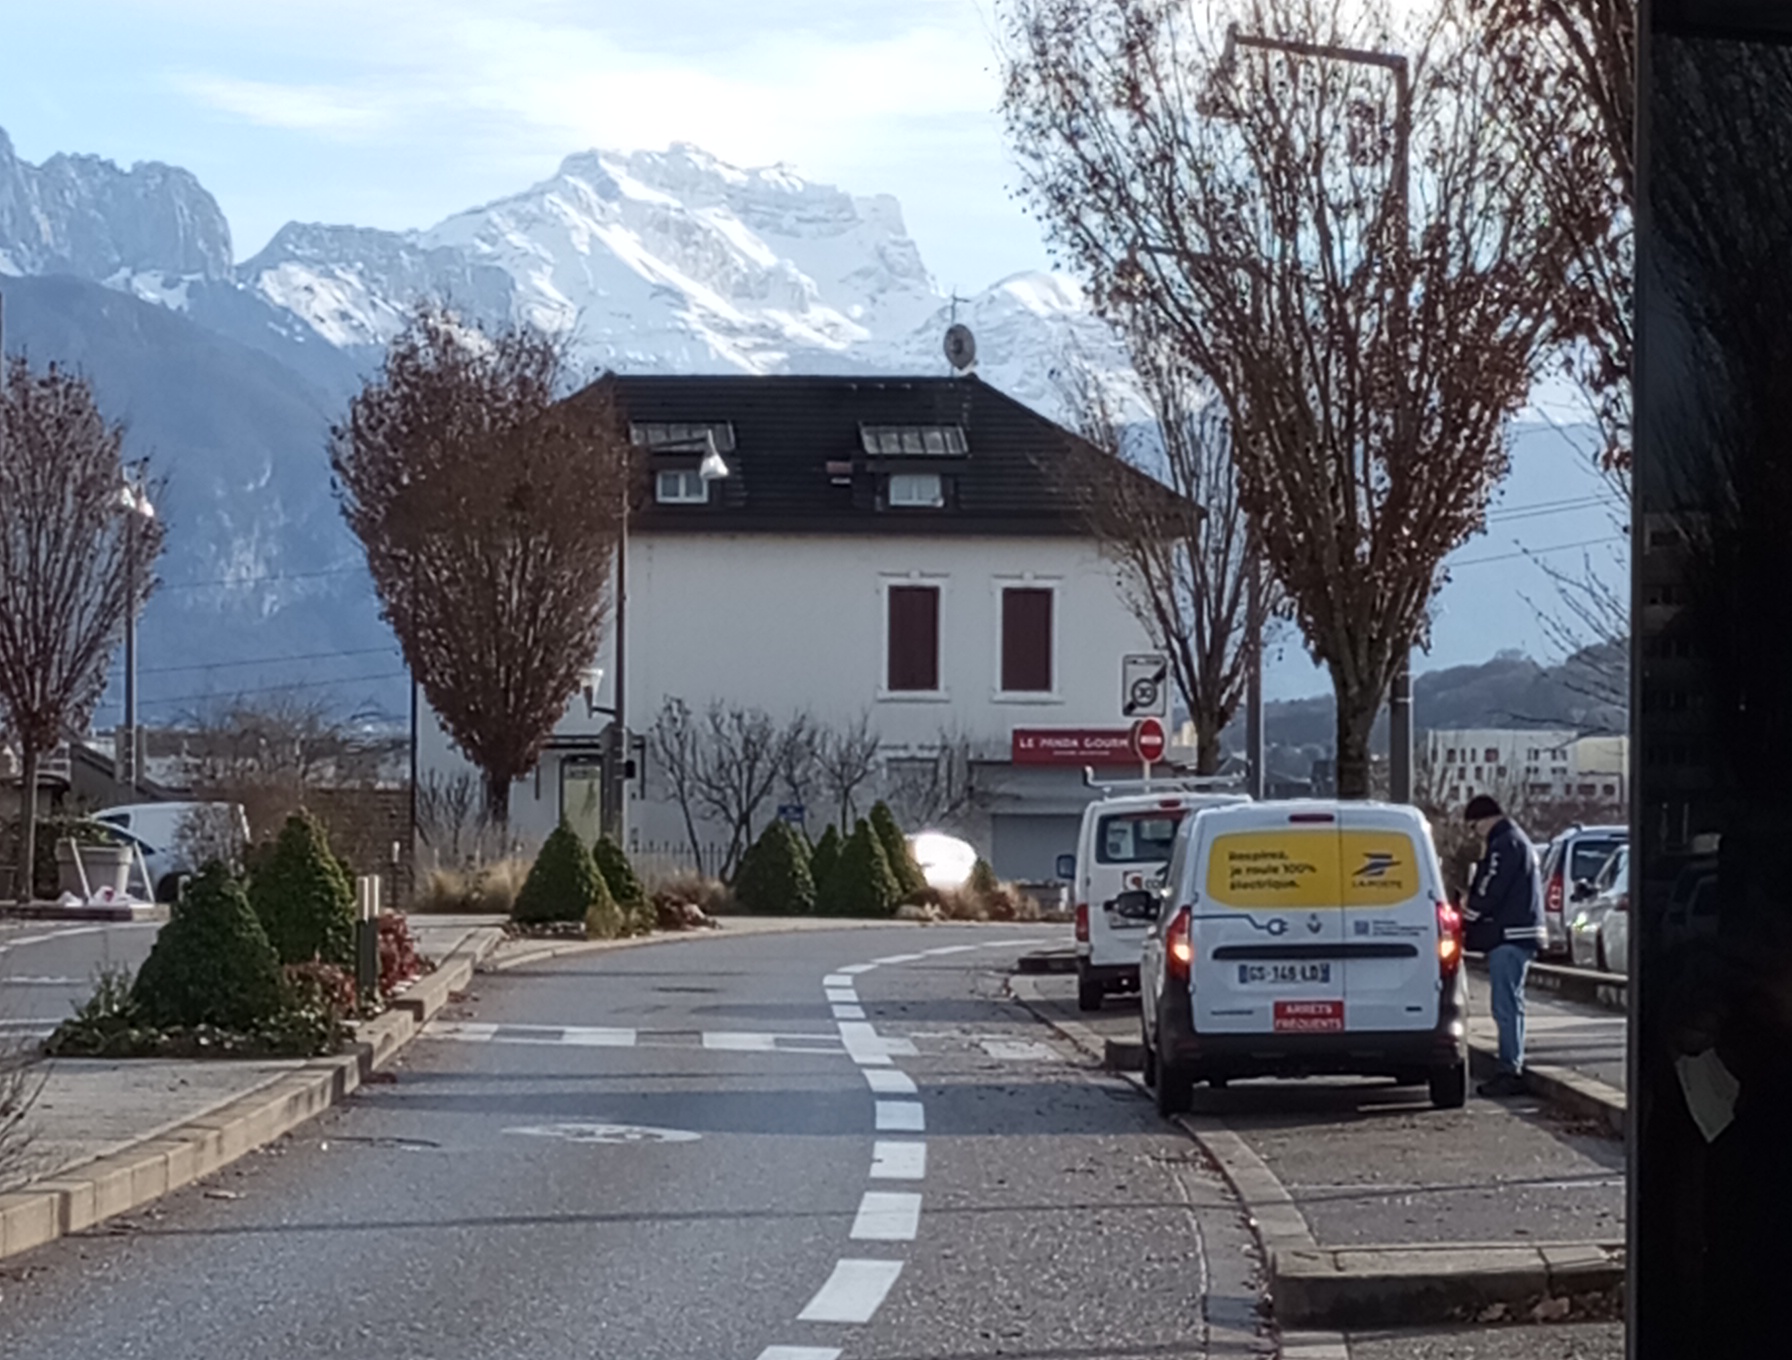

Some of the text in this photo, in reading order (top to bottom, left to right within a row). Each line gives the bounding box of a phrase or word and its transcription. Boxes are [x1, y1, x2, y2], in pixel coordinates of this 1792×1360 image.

[1019, 738, 1034, 749] LE
[1083, 737, 1129, 748] GOURM
[1230, 863, 1317, 879] je roule 100%
[1367, 880, 1403, 890] POSTE
